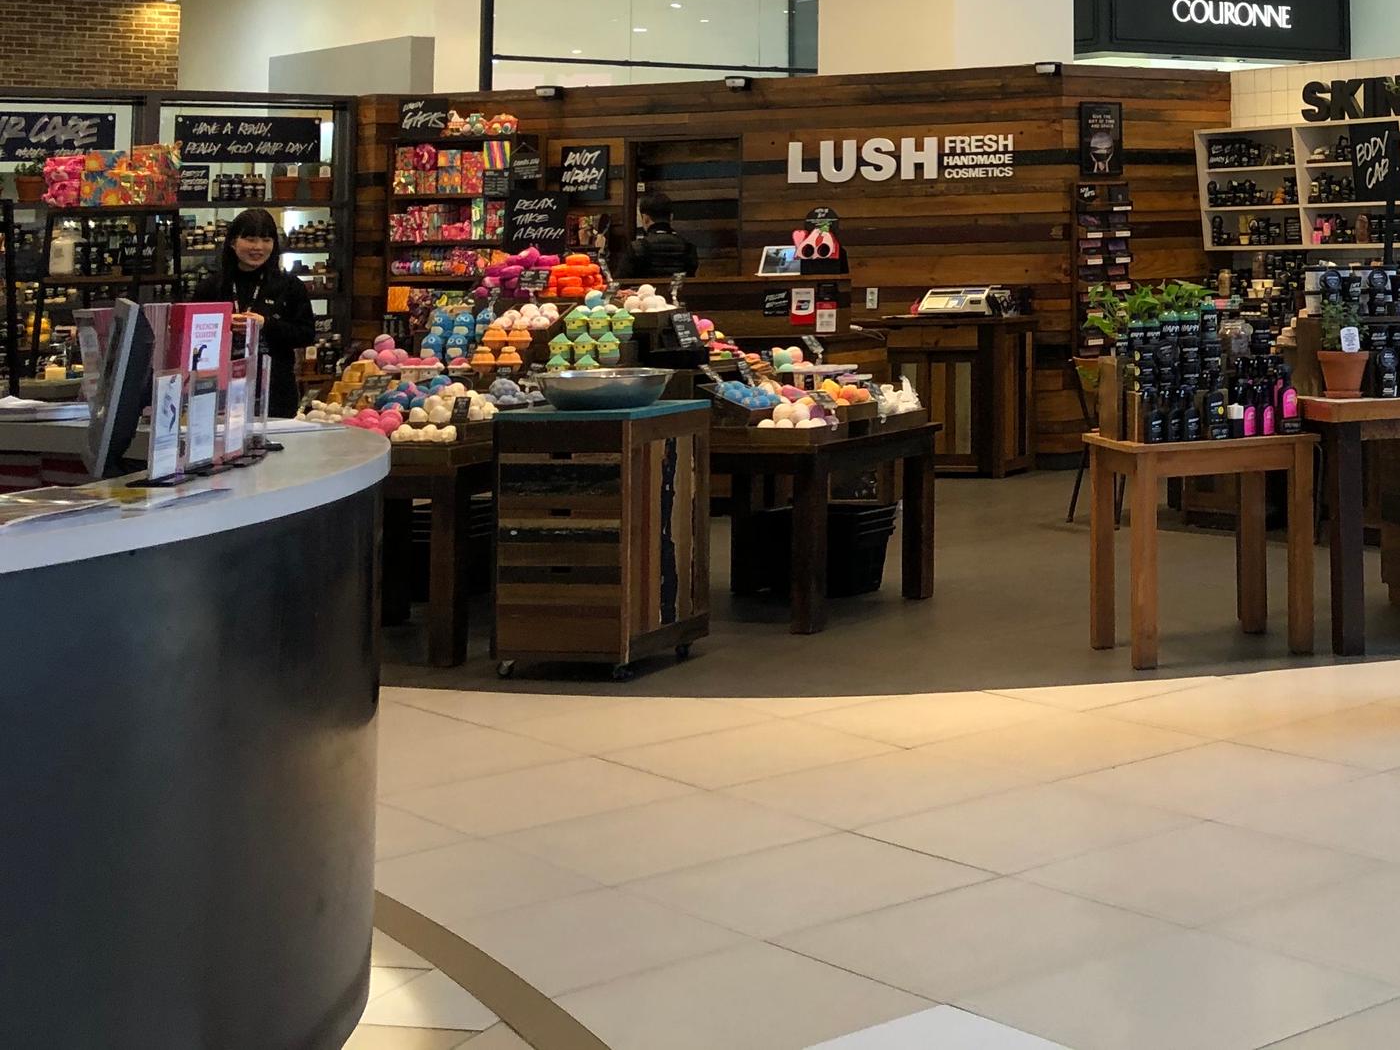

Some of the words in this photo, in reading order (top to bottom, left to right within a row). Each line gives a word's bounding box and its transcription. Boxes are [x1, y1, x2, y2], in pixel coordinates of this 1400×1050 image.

[28, 113, 101, 148] CARE
[1355, 130, 1389, 167] BODY
[564, 149, 602, 168] KNOT
[787, 136, 939, 184] LUSH
[944, 133, 1014, 154] FRESH
[943, 153, 1014, 166] HANDMADE
[944, 166, 1014, 179] COSMETICS
[513, 197, 558, 211] RELAX,
[511, 213, 550, 226] TAKE
